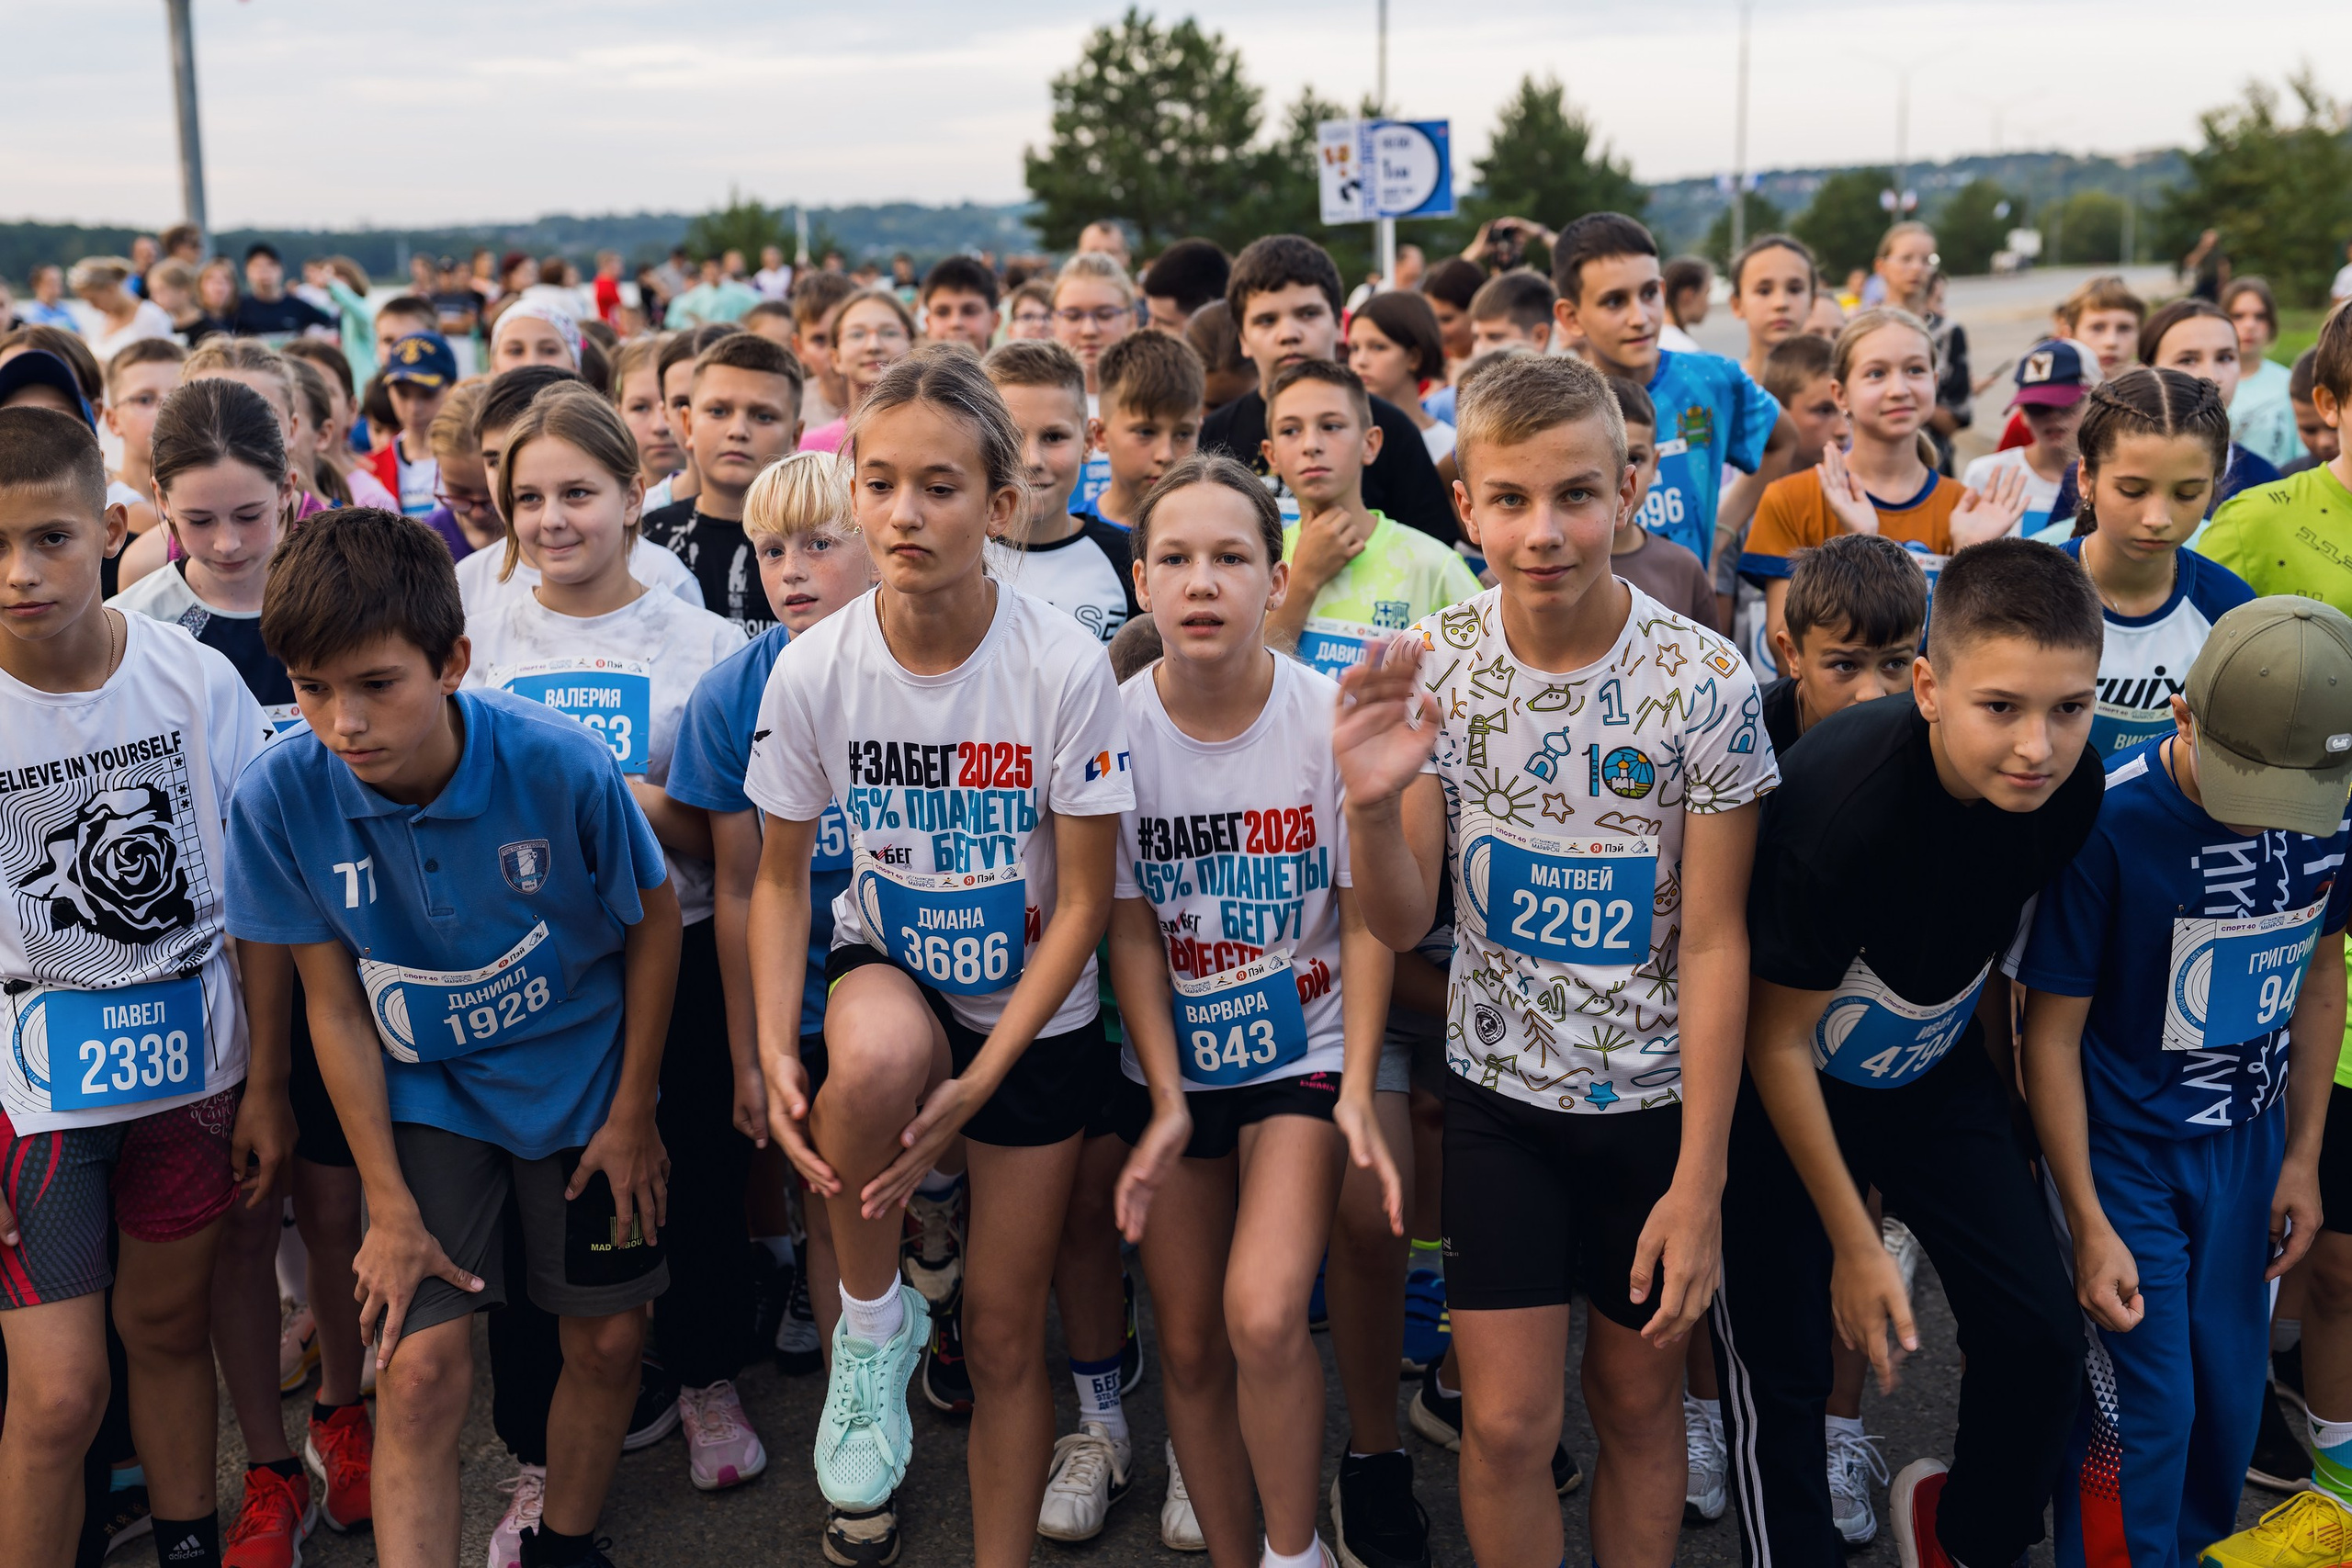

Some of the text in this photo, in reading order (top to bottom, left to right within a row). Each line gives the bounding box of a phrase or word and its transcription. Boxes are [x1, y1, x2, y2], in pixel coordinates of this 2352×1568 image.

[606, 660, 623, 670] Пэй
[545, 688, 621, 709] ВАЛЕРИЯ
[570, 714, 632, 761] 63
[0, 730, 182, 794] ELIEVE IN YOURSELF
[848, 740, 1035, 790] #ЗАБЕГ2025
[904, 787, 1039, 836] ПЛАНЕТЫ
[1137, 804, 1317, 862] #ЗАБЕГ2025
[1496, 827, 1517, 840] СПОРТ
[1531, 843, 1560, 852] МАРАФОН
[1604, 842, 1624, 853] Пэй
[932, 832, 1017, 874] БЕГУТ
[875, 863, 896, 876] СПОРТ
[908, 880, 935, 888] МАРАФОН
[977, 872, 995, 884] Пэй
[1195, 846, 1330, 900] ПЛАНЕТЫ
[1531, 863, 1613, 891] МАТВЕЙ
[918, 907, 985, 930] ДИАНА
[1220, 899, 1305, 945] БЕГУТ
[1511, 888, 1634, 949] 2292
[2221, 924, 2245, 932] СПОРТ
[509, 946, 526, 963] Пэй
[901, 926, 1009, 984] 3686
[2248, 927, 2319, 975] ГРИГОРИЙ
[403, 973, 428, 981] СПОРТ
[1248, 964, 1265, 977] Пэй
[447, 965, 528, 1010] ДАНИИЛ
[103, 1001, 166, 1030] ПАВЕЛ
[443, 976, 550, 1046] 1928
[1185, 991, 1270, 1024] ВАРВАРА
[1191, 1020, 1277, 1072] 843
[1860, 1020, 1963, 1079] 4794
[79, 1030, 189, 1095] 2338
[617, 1238, 643, 1250] BOU
[1092, 1372, 1117, 1393] БЕГ
[168, 1549, 205, 1561] adidas
